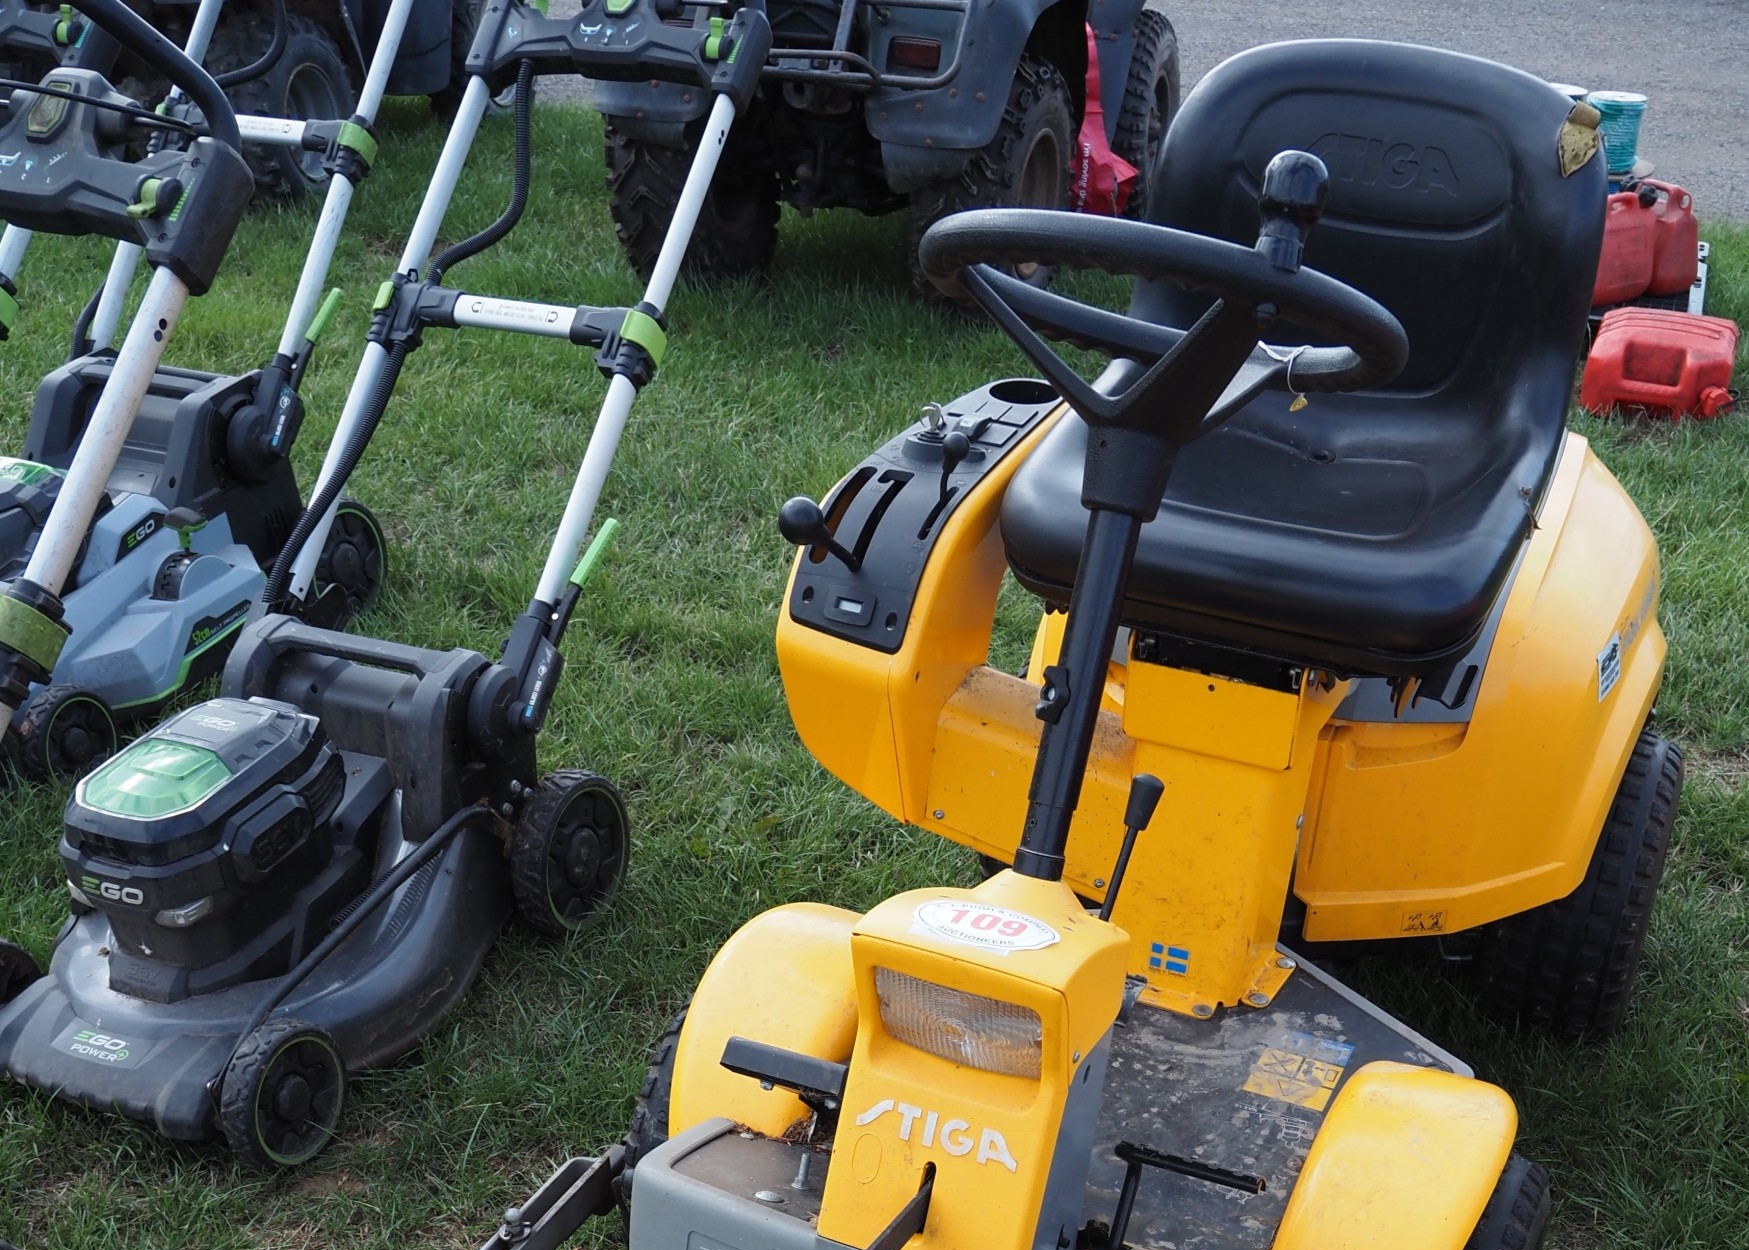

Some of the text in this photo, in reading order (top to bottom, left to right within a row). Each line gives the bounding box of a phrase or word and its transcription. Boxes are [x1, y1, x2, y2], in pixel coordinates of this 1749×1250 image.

[127, 519, 155, 548] EGO
[190, 714, 236, 727] EGO
[81, 875, 144, 905] EGO
[937, 925, 1015, 946] AUCTIONEERS
[950, 908, 1029, 938] 109
[73, 1030, 127, 1051] EGO
[855, 1099, 1018, 1173] STIGA
